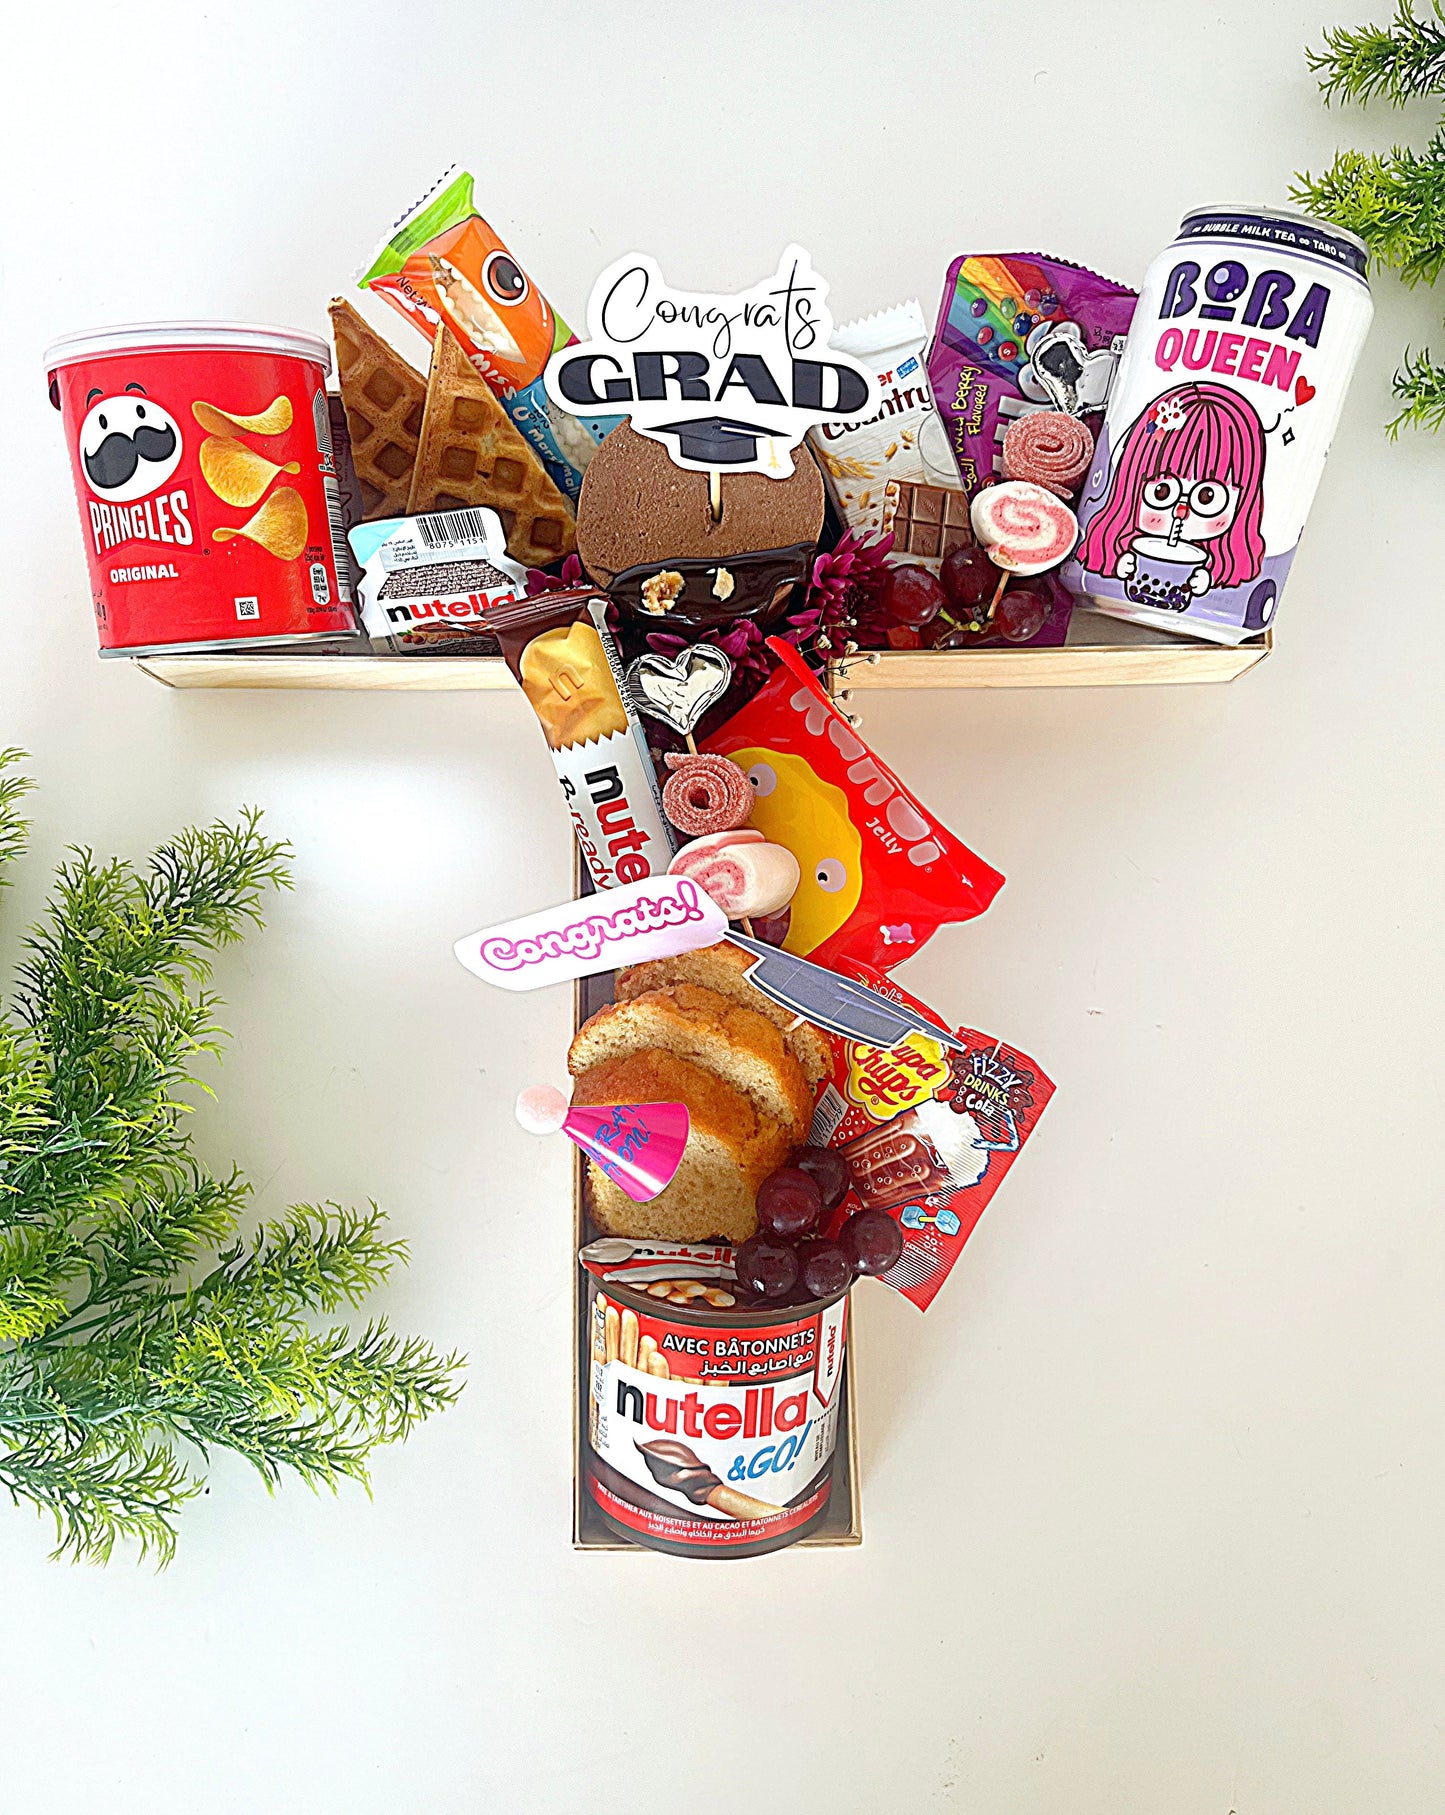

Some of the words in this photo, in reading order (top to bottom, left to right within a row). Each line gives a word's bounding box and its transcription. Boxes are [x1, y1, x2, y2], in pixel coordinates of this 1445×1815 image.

[1201, 223, 1239, 233] BUBBLE
[1240, 224, 1270, 237] MILK
[1275, 229, 1296, 242] TEA
[1312, 239, 1337, 256] TARO
[396, 276, 418, 300] Net
[602, 259, 821, 359] Congrats
[470, 353, 518, 401] MISS
[1155, 327, 1302, 392] QUEEN
[558, 351, 869, 414] GRAD
[89, 489, 193, 555] PRINGLES
[110, 563, 179, 583] ORIGINAL
[584, 764, 652, 885] nute
[865, 817, 903, 854] Jelly
[480, 880, 704, 971] Congrats!
[964, 1074, 1010, 1104] DRINKS
[972, 1055, 1022, 1091] FIZZY
[662, 1332, 708, 1356] AVEC
[714, 1327, 816, 1358] BÂTONNETS
[791, 1349, 813, 1369] مع
[826, 1326, 836, 1378] nutella
[699, 1360, 747, 1377] الخبز
[617, 1378, 809, 1440] nutella
[727, 1419, 813, 1481] &GO!
[638, 1508, 653, 1519] AUX
[653, 1513, 691, 1528] NOISETTES
[692, 1521, 701, 1529] ET
[703, 1522, 713, 1530] AU
[714, 1521, 740, 1531] CACAO
[741, 1520, 750, 1529] ET
